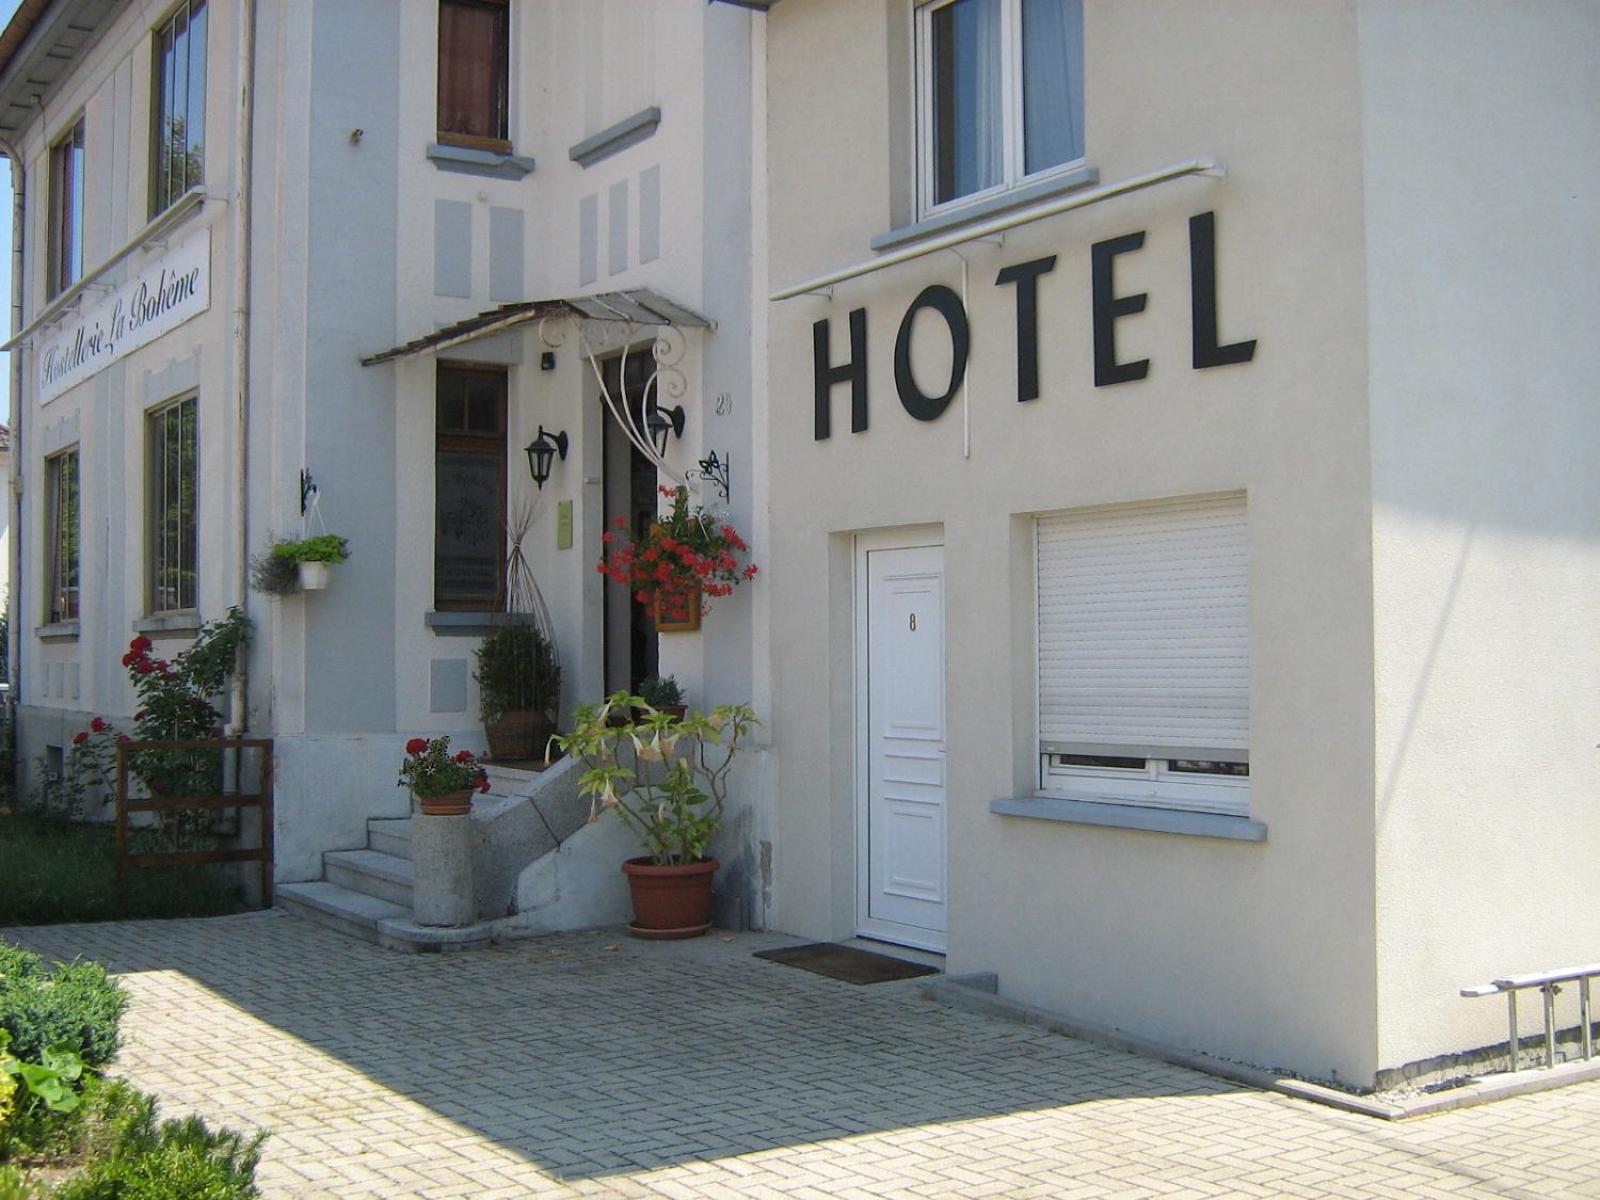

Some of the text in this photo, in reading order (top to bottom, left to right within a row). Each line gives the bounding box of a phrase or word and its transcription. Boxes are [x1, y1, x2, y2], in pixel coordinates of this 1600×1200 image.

[41, 267, 200, 388] Hostellerie La Bohême
[813, 211, 1258, 441] HOTEL
[909, 612, 917, 632] 8
